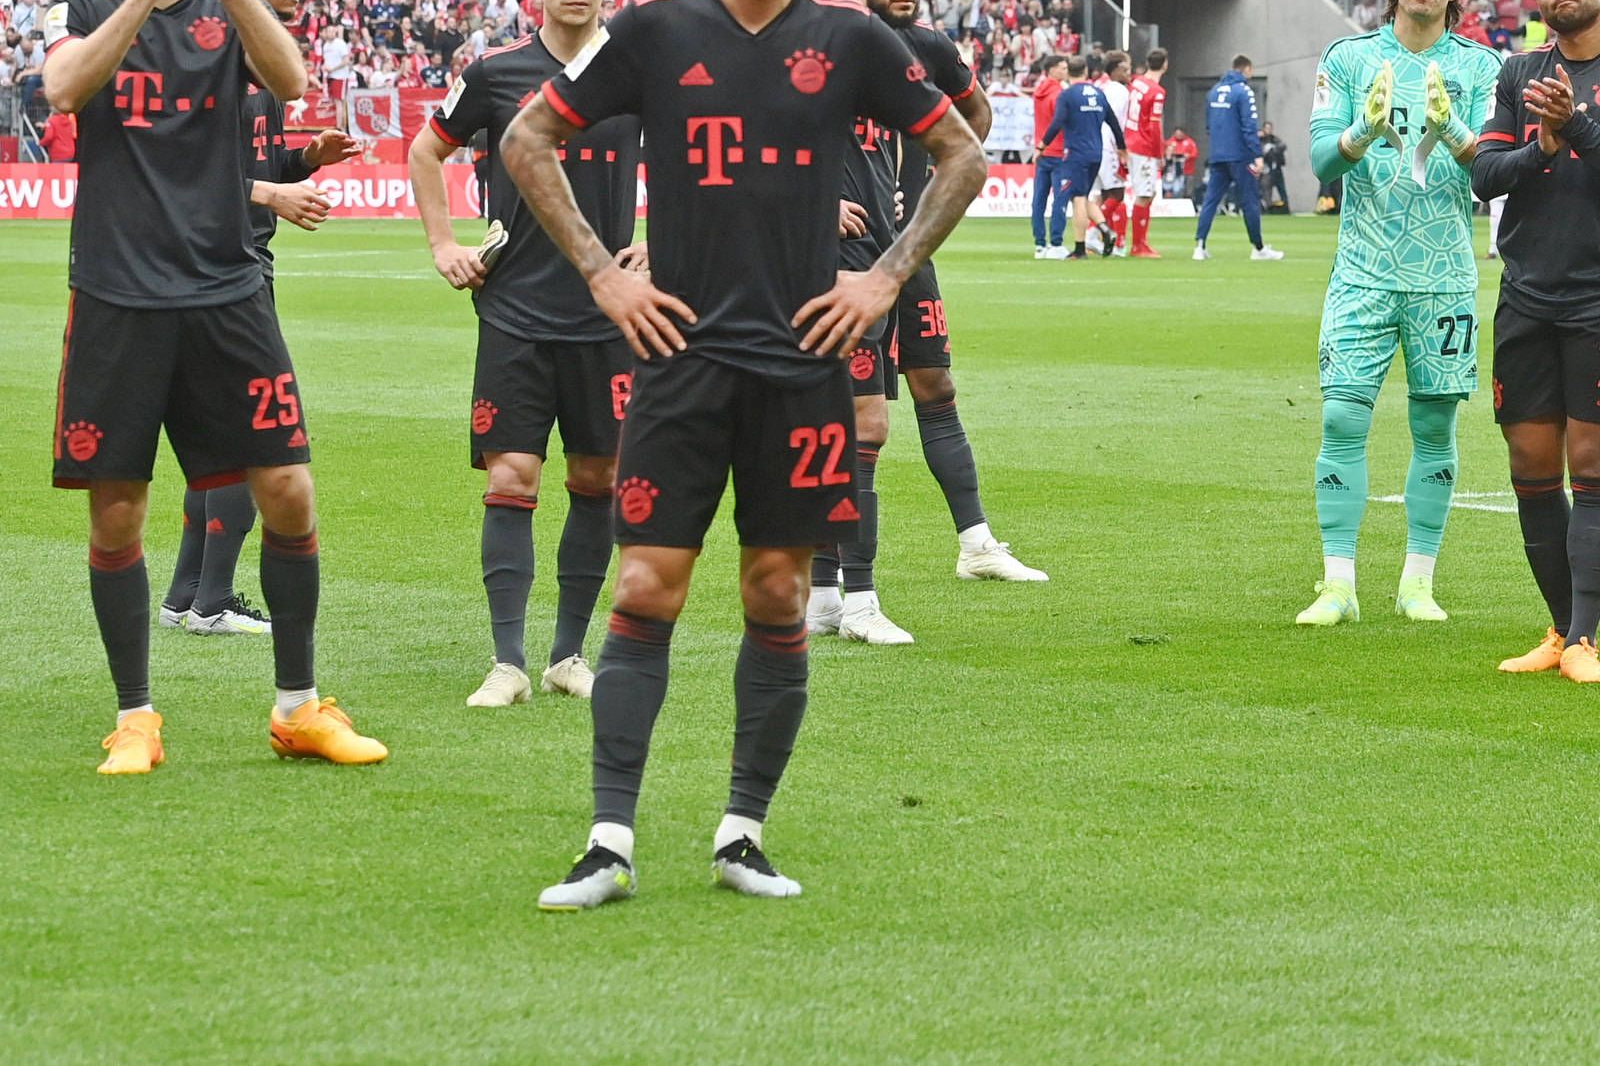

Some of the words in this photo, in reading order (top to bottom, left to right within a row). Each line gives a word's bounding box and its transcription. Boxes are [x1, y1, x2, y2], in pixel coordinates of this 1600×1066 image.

[917, 299, 948, 337] 38
[1437, 314, 1475, 357] 27
[248, 373, 299, 430] 25
[789, 423, 850, 488] 22
